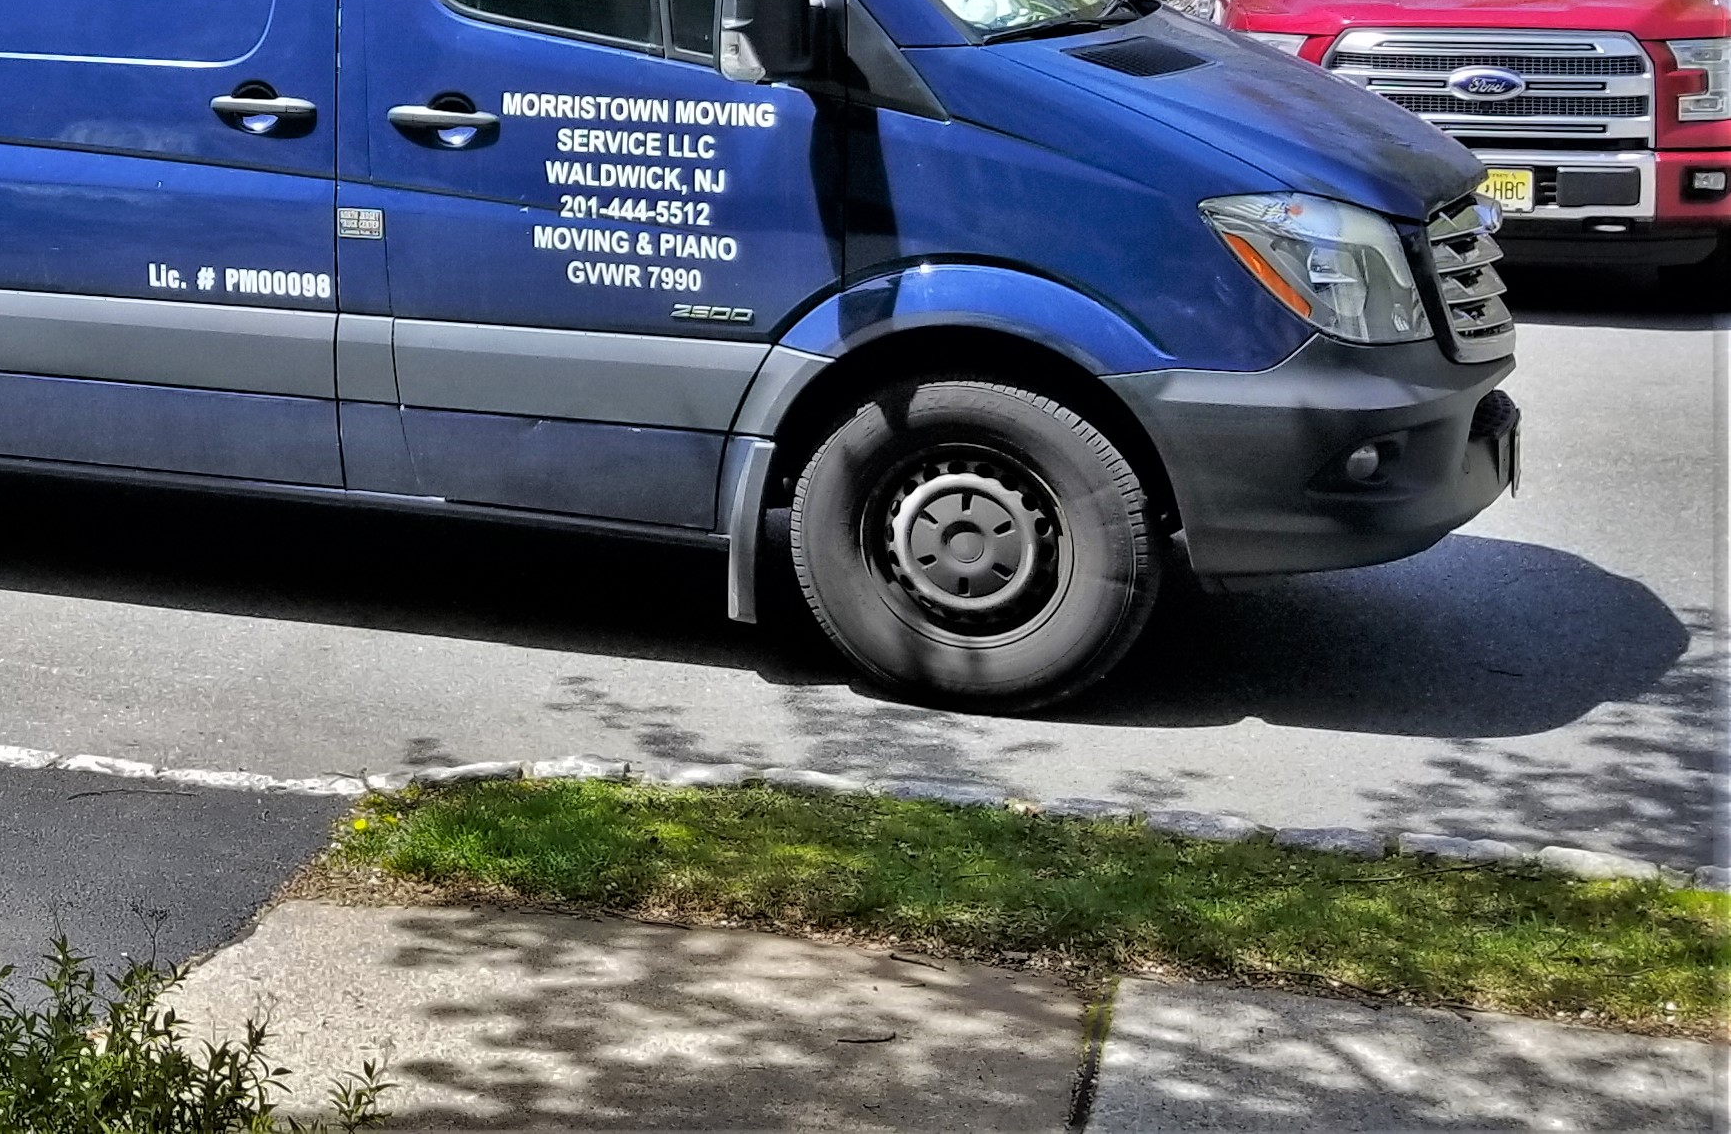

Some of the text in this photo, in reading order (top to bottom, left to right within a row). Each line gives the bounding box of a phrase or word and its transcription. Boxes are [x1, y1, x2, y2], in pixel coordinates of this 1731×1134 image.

[1469, 77, 1507, 93] Ford
[502, 92, 777, 128] MORRISTOWN MOVING
[557, 128, 716, 159] SERVICE LLC
[545, 160, 726, 196] WALDWICK, NJ
[1493, 181, 1526, 200] HBC
[559, 194, 710, 226] 201-444-5512
[534, 225, 738, 261] MOVING & PIANO
[148, 263, 331, 299] Lic. # PM00098
[567, 260, 702, 292] GVWR 7990
[670, 303, 754, 322] 2500
